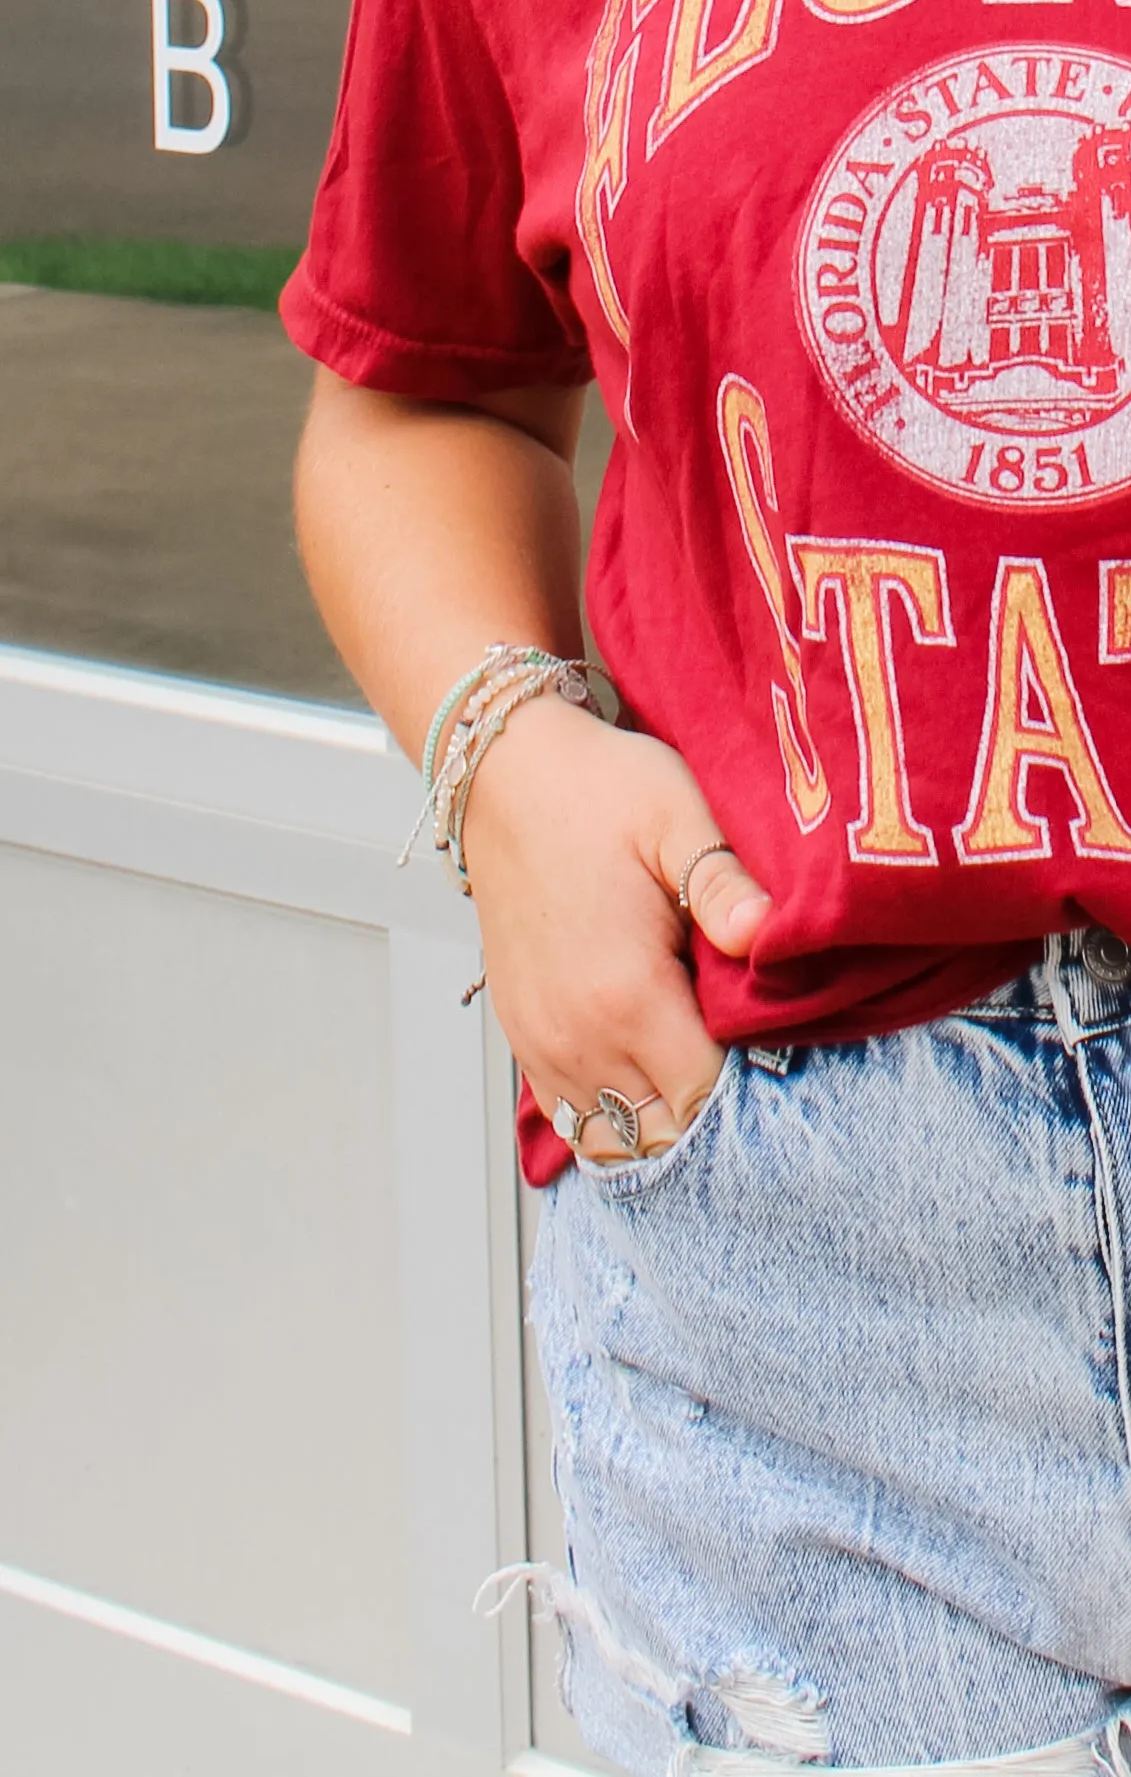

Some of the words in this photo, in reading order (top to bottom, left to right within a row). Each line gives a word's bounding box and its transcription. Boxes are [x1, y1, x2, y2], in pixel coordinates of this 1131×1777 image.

[815, 160, 899, 415] FLORIDA
[902, 56, 1092, 142] STATE
[958, 441, 1096, 493] 1851
